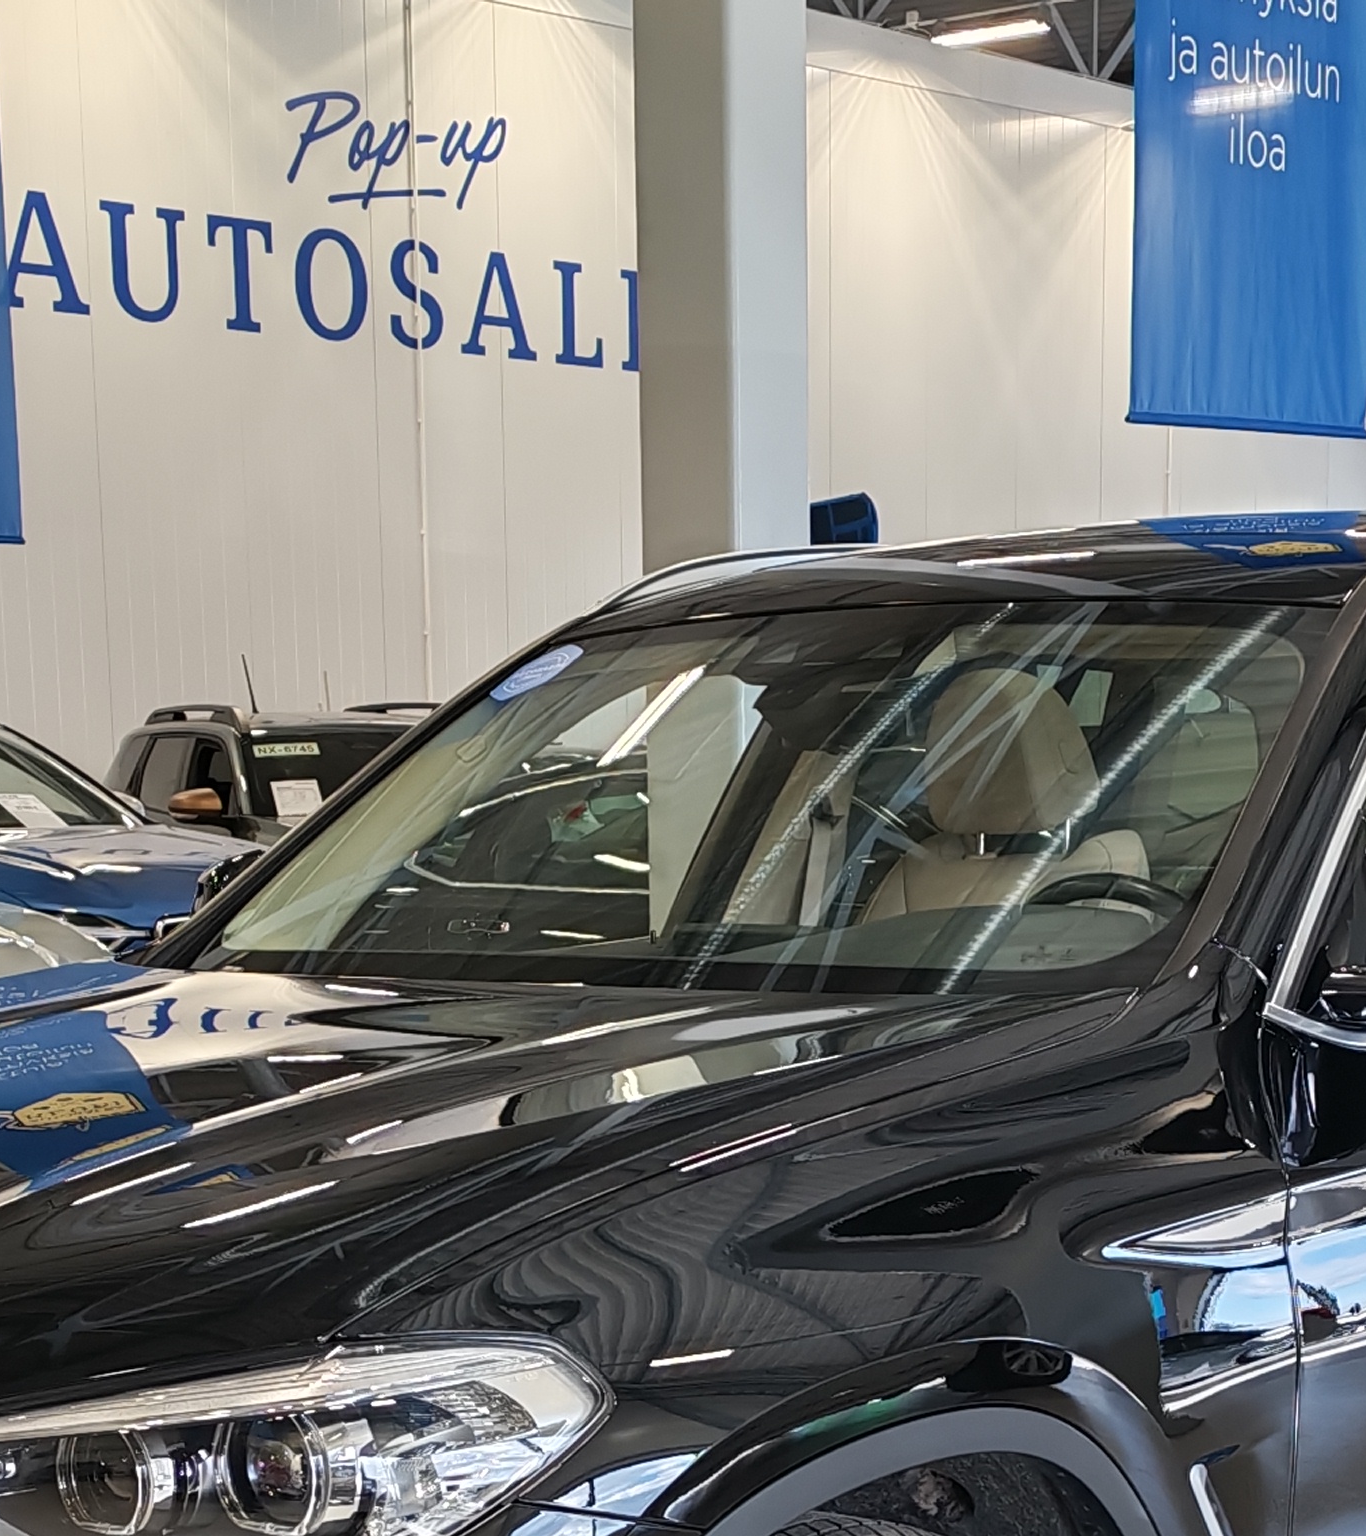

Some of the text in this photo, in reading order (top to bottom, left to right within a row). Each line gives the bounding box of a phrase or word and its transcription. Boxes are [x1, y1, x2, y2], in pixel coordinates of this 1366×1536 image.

[1168, 18, 1340, 103] ja autoilun
[285, 90, 507, 209] Pop-up
[1229, 113, 1285, 171] iloa
